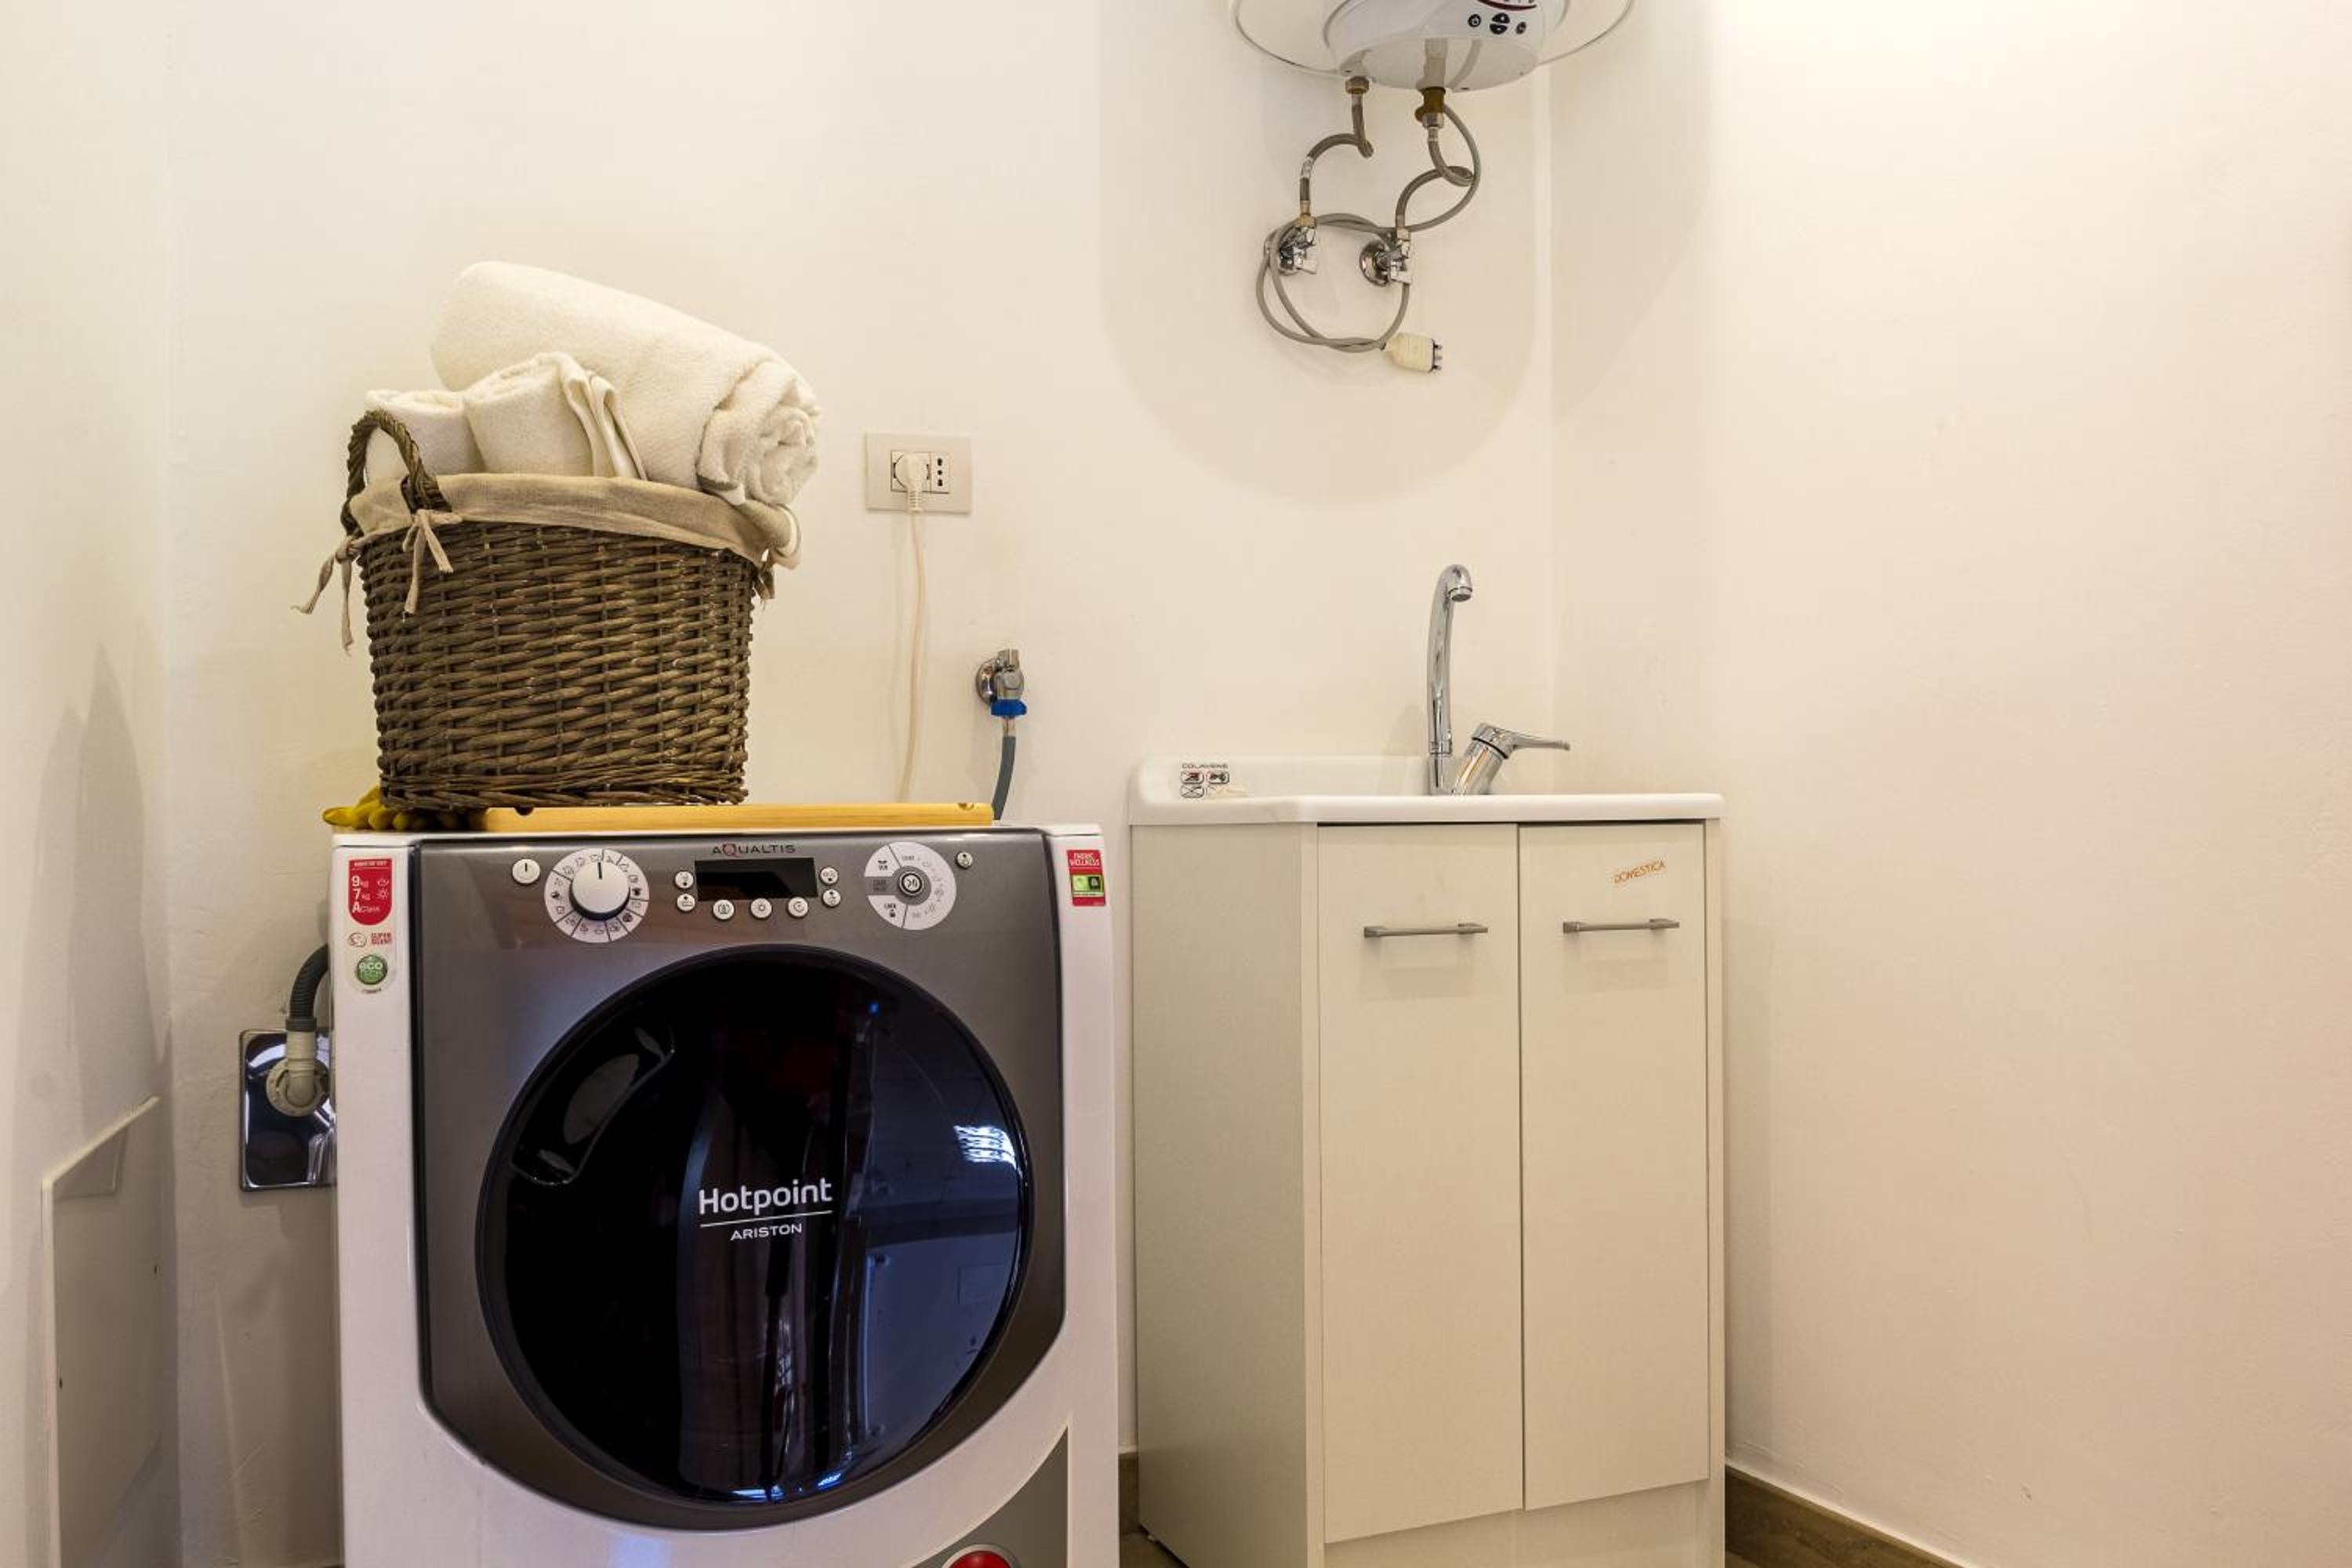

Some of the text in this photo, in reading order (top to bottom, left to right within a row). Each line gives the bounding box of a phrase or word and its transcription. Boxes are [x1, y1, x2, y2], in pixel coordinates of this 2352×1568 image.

[713, 843, 797, 858] AQUALTIS
[1613, 860, 1666, 884] DOMESTICA
[699, 1178, 833, 1216] Hotpoint
[730, 1223, 802, 1241] ARISTON
